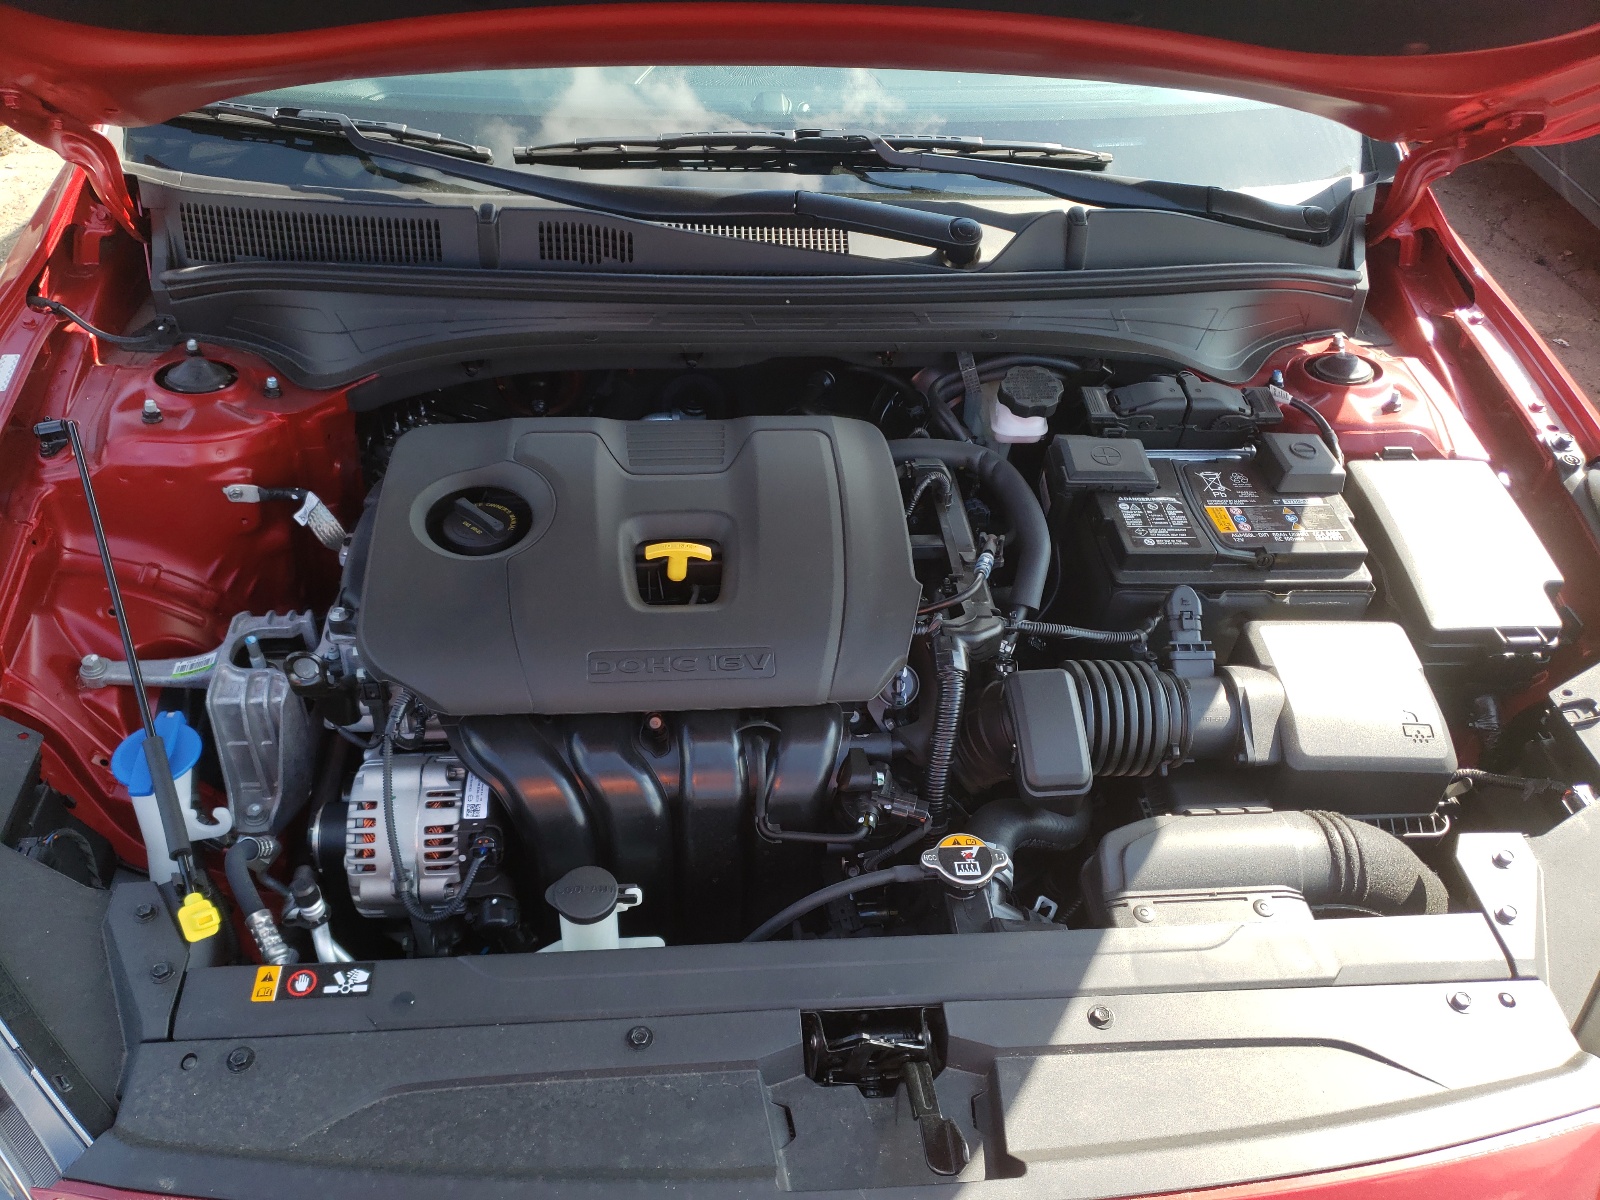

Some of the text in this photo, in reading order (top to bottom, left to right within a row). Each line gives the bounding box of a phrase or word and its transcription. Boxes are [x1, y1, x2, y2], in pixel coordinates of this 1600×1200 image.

[590, 652, 772, 675] DOHC 16V
[994, 853, 1006, 861] 1.1
